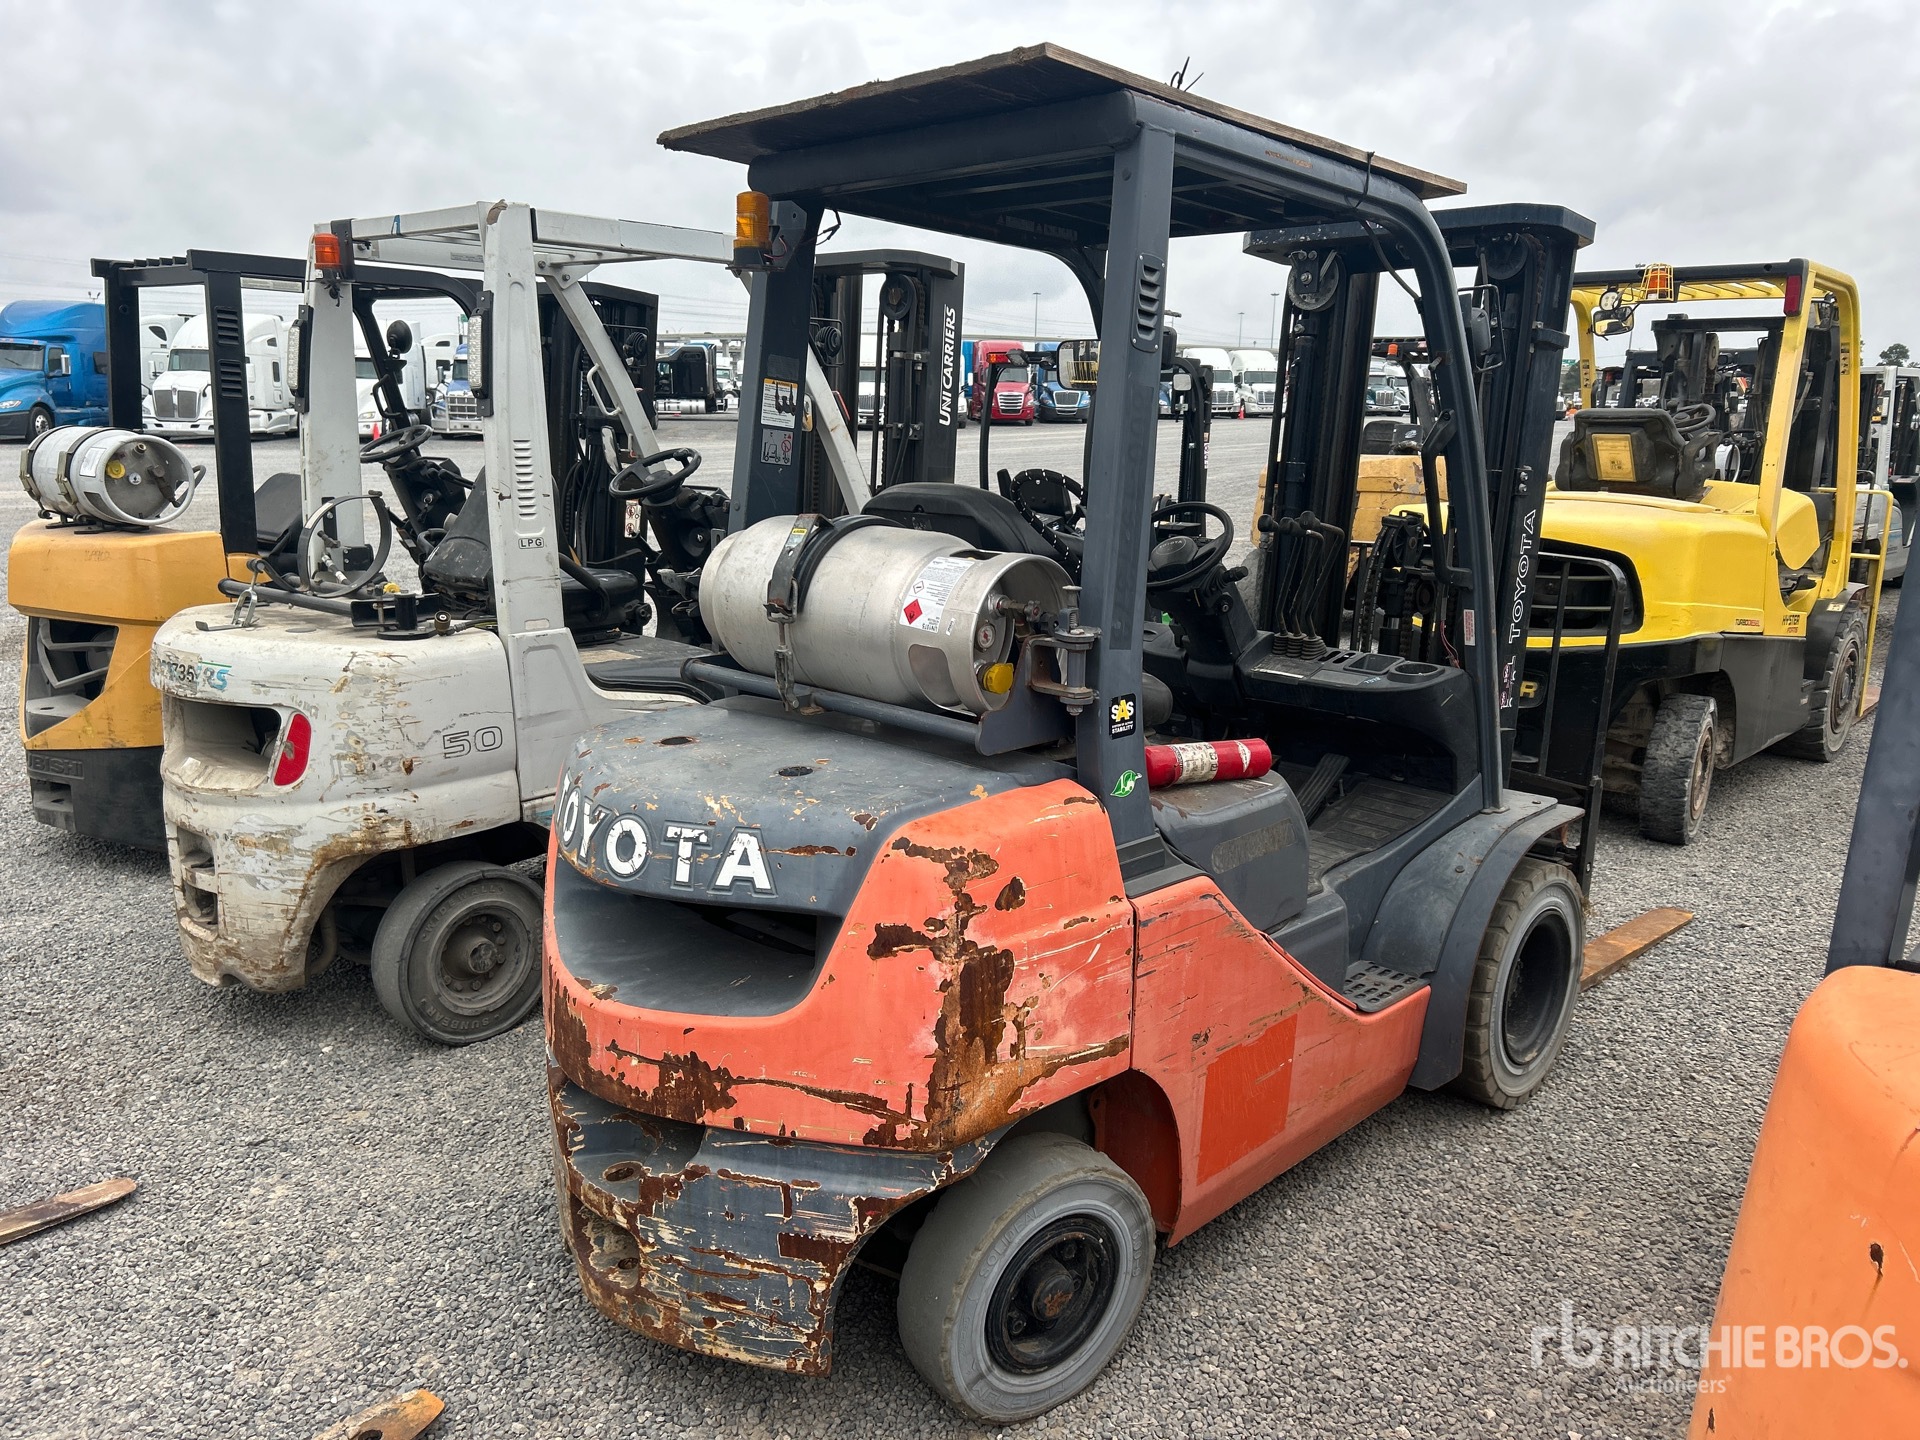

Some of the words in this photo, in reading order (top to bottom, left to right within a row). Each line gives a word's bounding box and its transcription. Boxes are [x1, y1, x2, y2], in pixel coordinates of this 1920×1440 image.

[939, 306, 956, 426] UNICARRIERS
[520, 538, 543, 548] LPG
[1509, 509, 1537, 643] TOYOTA
[1111, 699, 1135, 723] SAS
[443, 726, 503, 759] 50
[556, 770, 774, 892] TOYOTA
[426, 1006, 490, 1030] SUNBEAR
[979, 1206, 1043, 1278] SOLIDEAL
